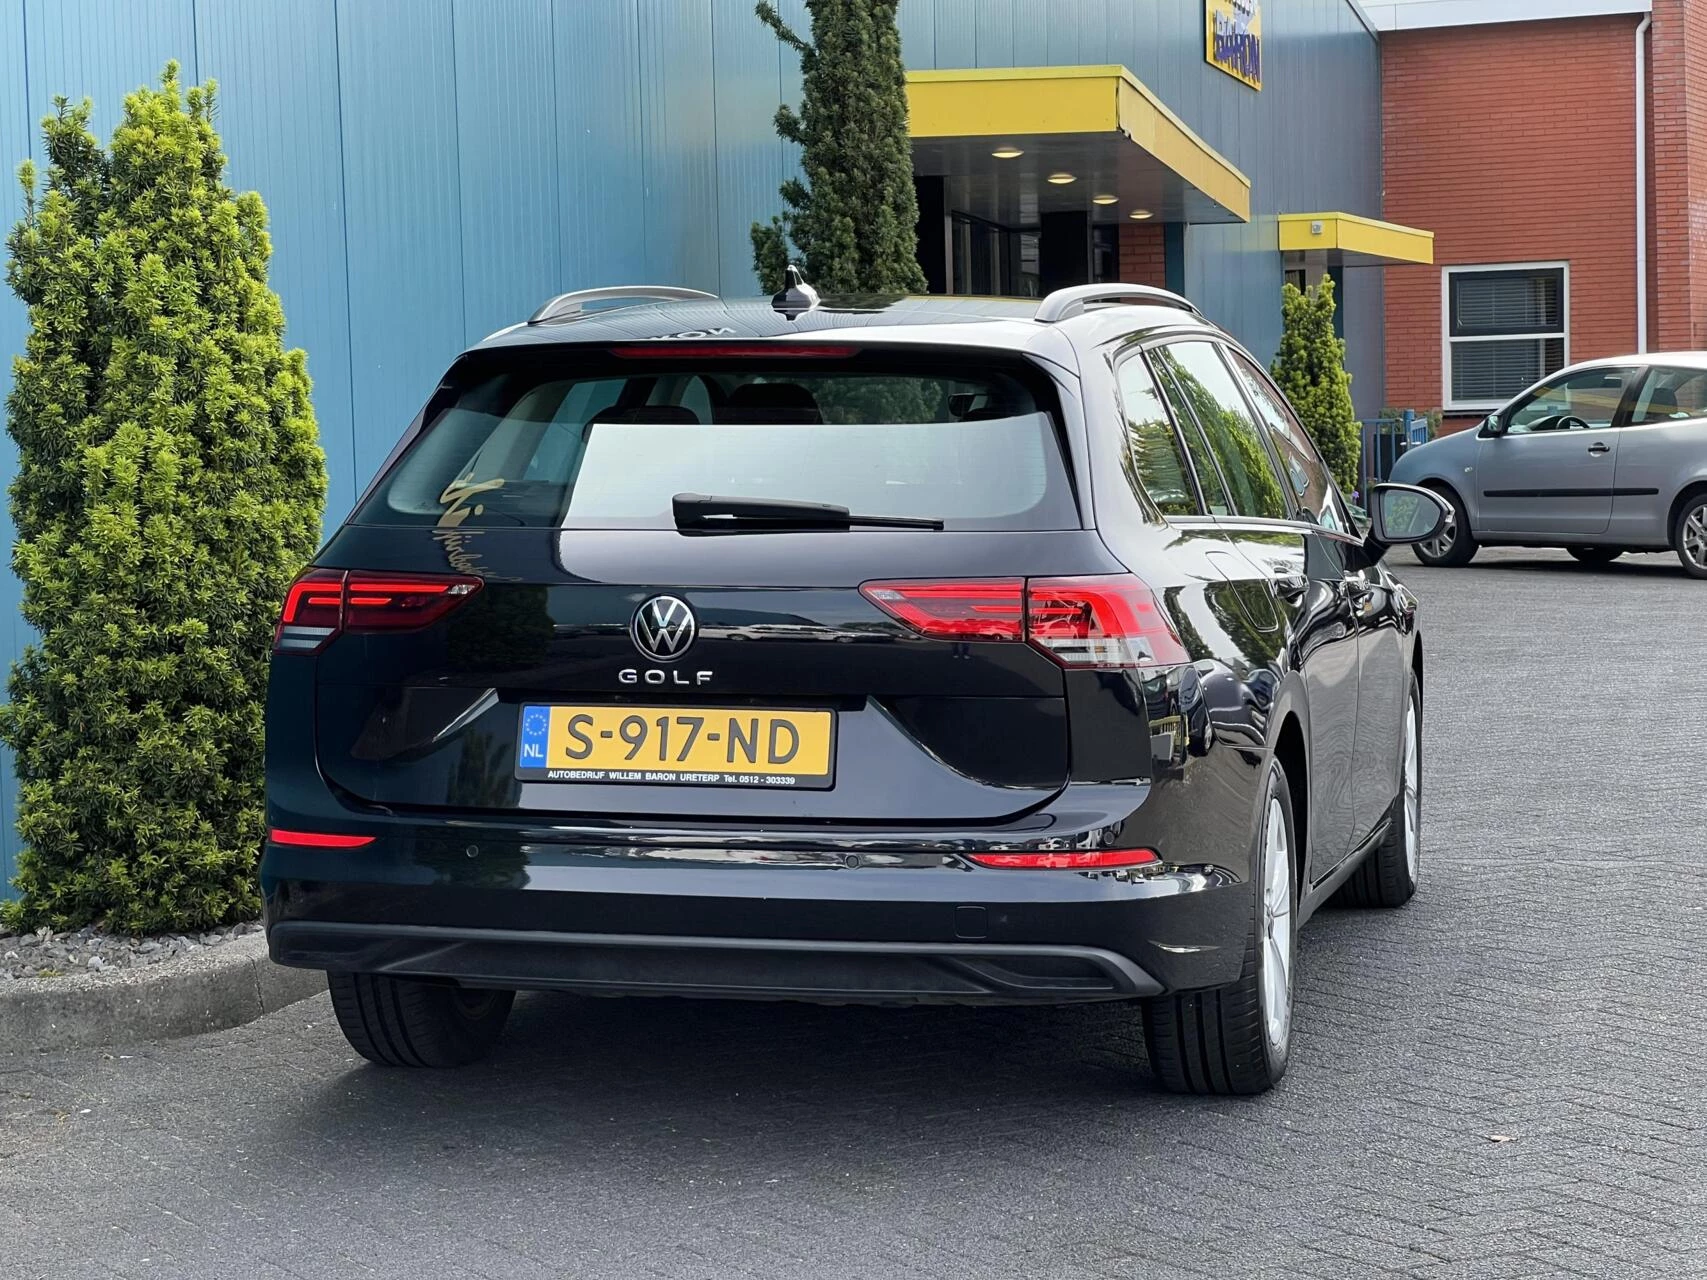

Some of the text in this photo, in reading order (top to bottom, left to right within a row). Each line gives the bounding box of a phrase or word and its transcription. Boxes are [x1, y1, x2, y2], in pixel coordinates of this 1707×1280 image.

[618, 668, 713, 685] GOLF
[566, 713, 799, 764] S-917-ND
[523, 743, 544, 758] NL
[547, 770, 606, 780] AUTOBEDRIJF
[608, 771, 641, 780] WILLEM
[645, 772, 677, 781] BARON
[680, 773, 720, 782] URETERP
[723, 774, 737, 783] Tel.
[739, 775, 759, 784] 0512
[765, 776, 796, 785] 303339
